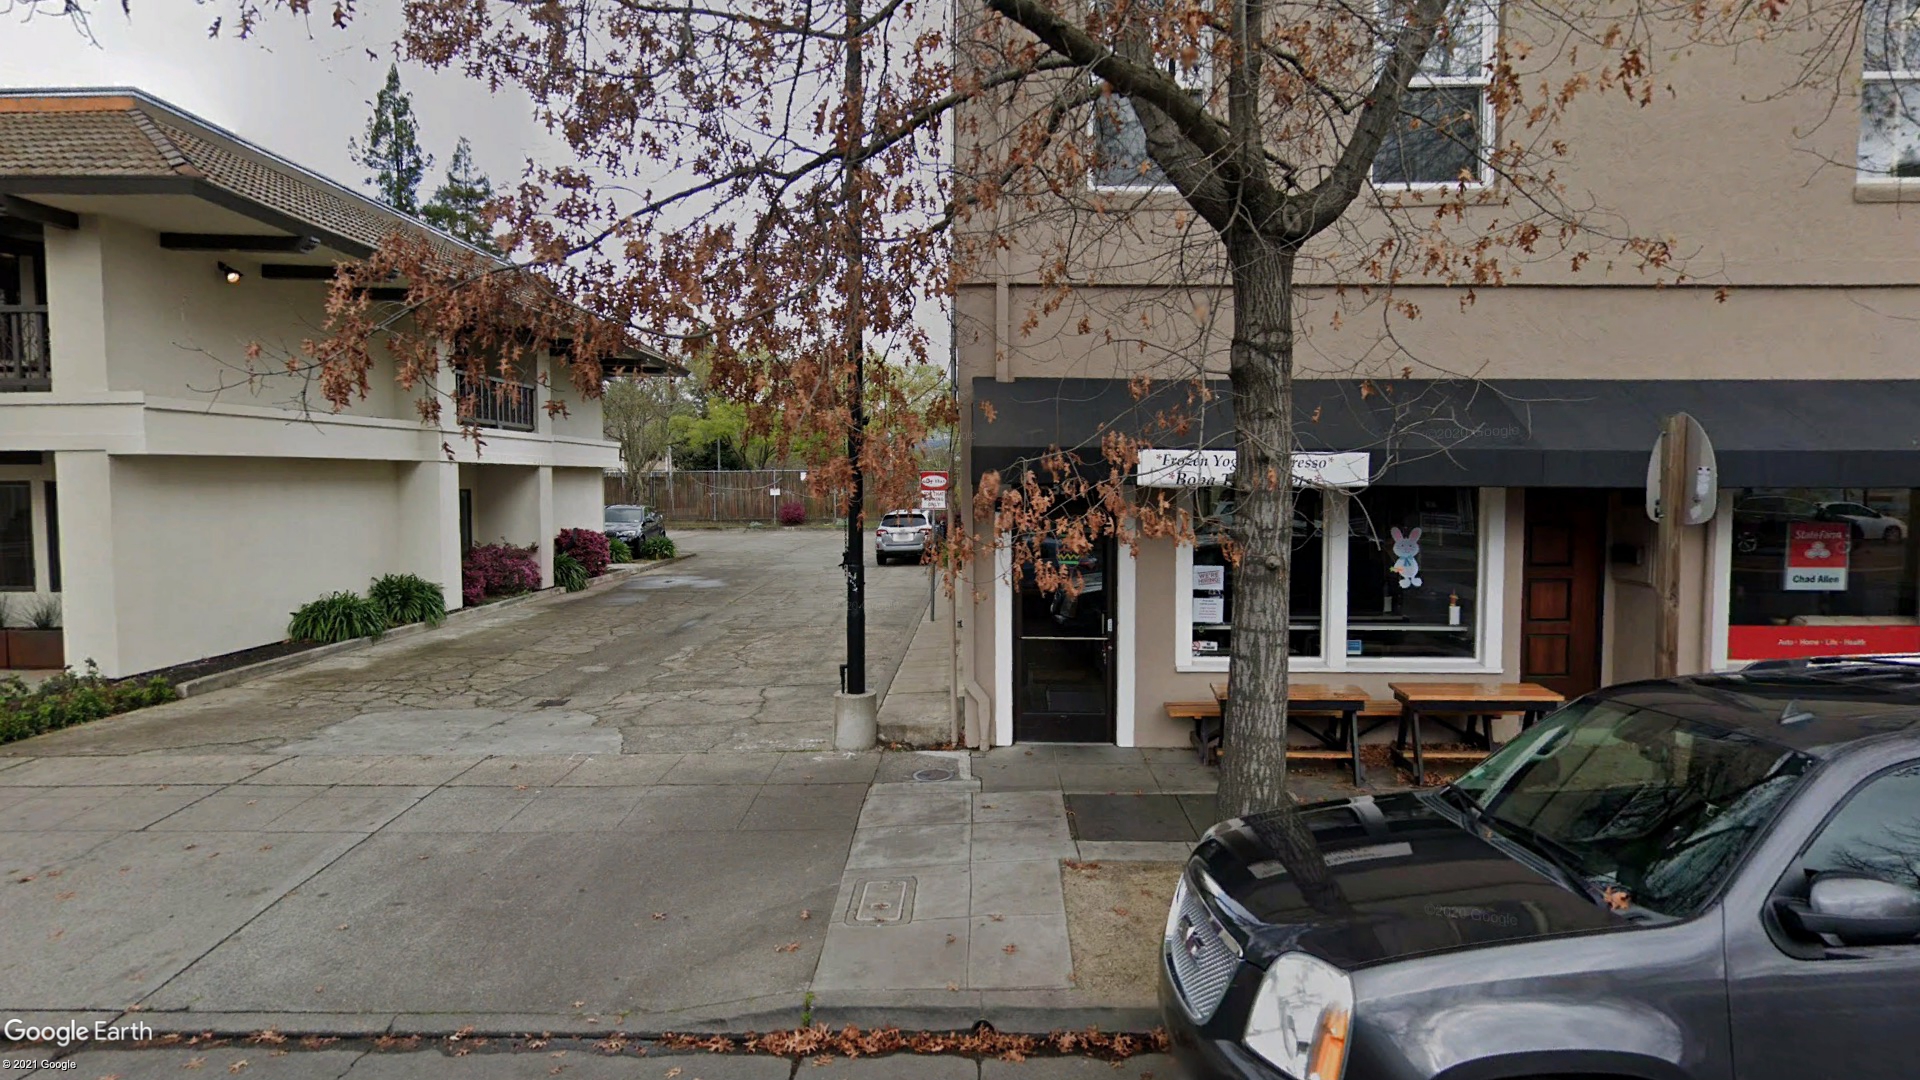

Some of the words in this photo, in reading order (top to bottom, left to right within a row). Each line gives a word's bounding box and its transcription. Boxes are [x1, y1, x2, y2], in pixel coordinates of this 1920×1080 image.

[1162, 452, 1208, 467] Frozen
[1792, 574, 1816, 583] Chad
[1817, 574, 1840, 583] Allen
[1825, 638, 1838, 646] Life
[1844, 638, 1866, 646] Health
